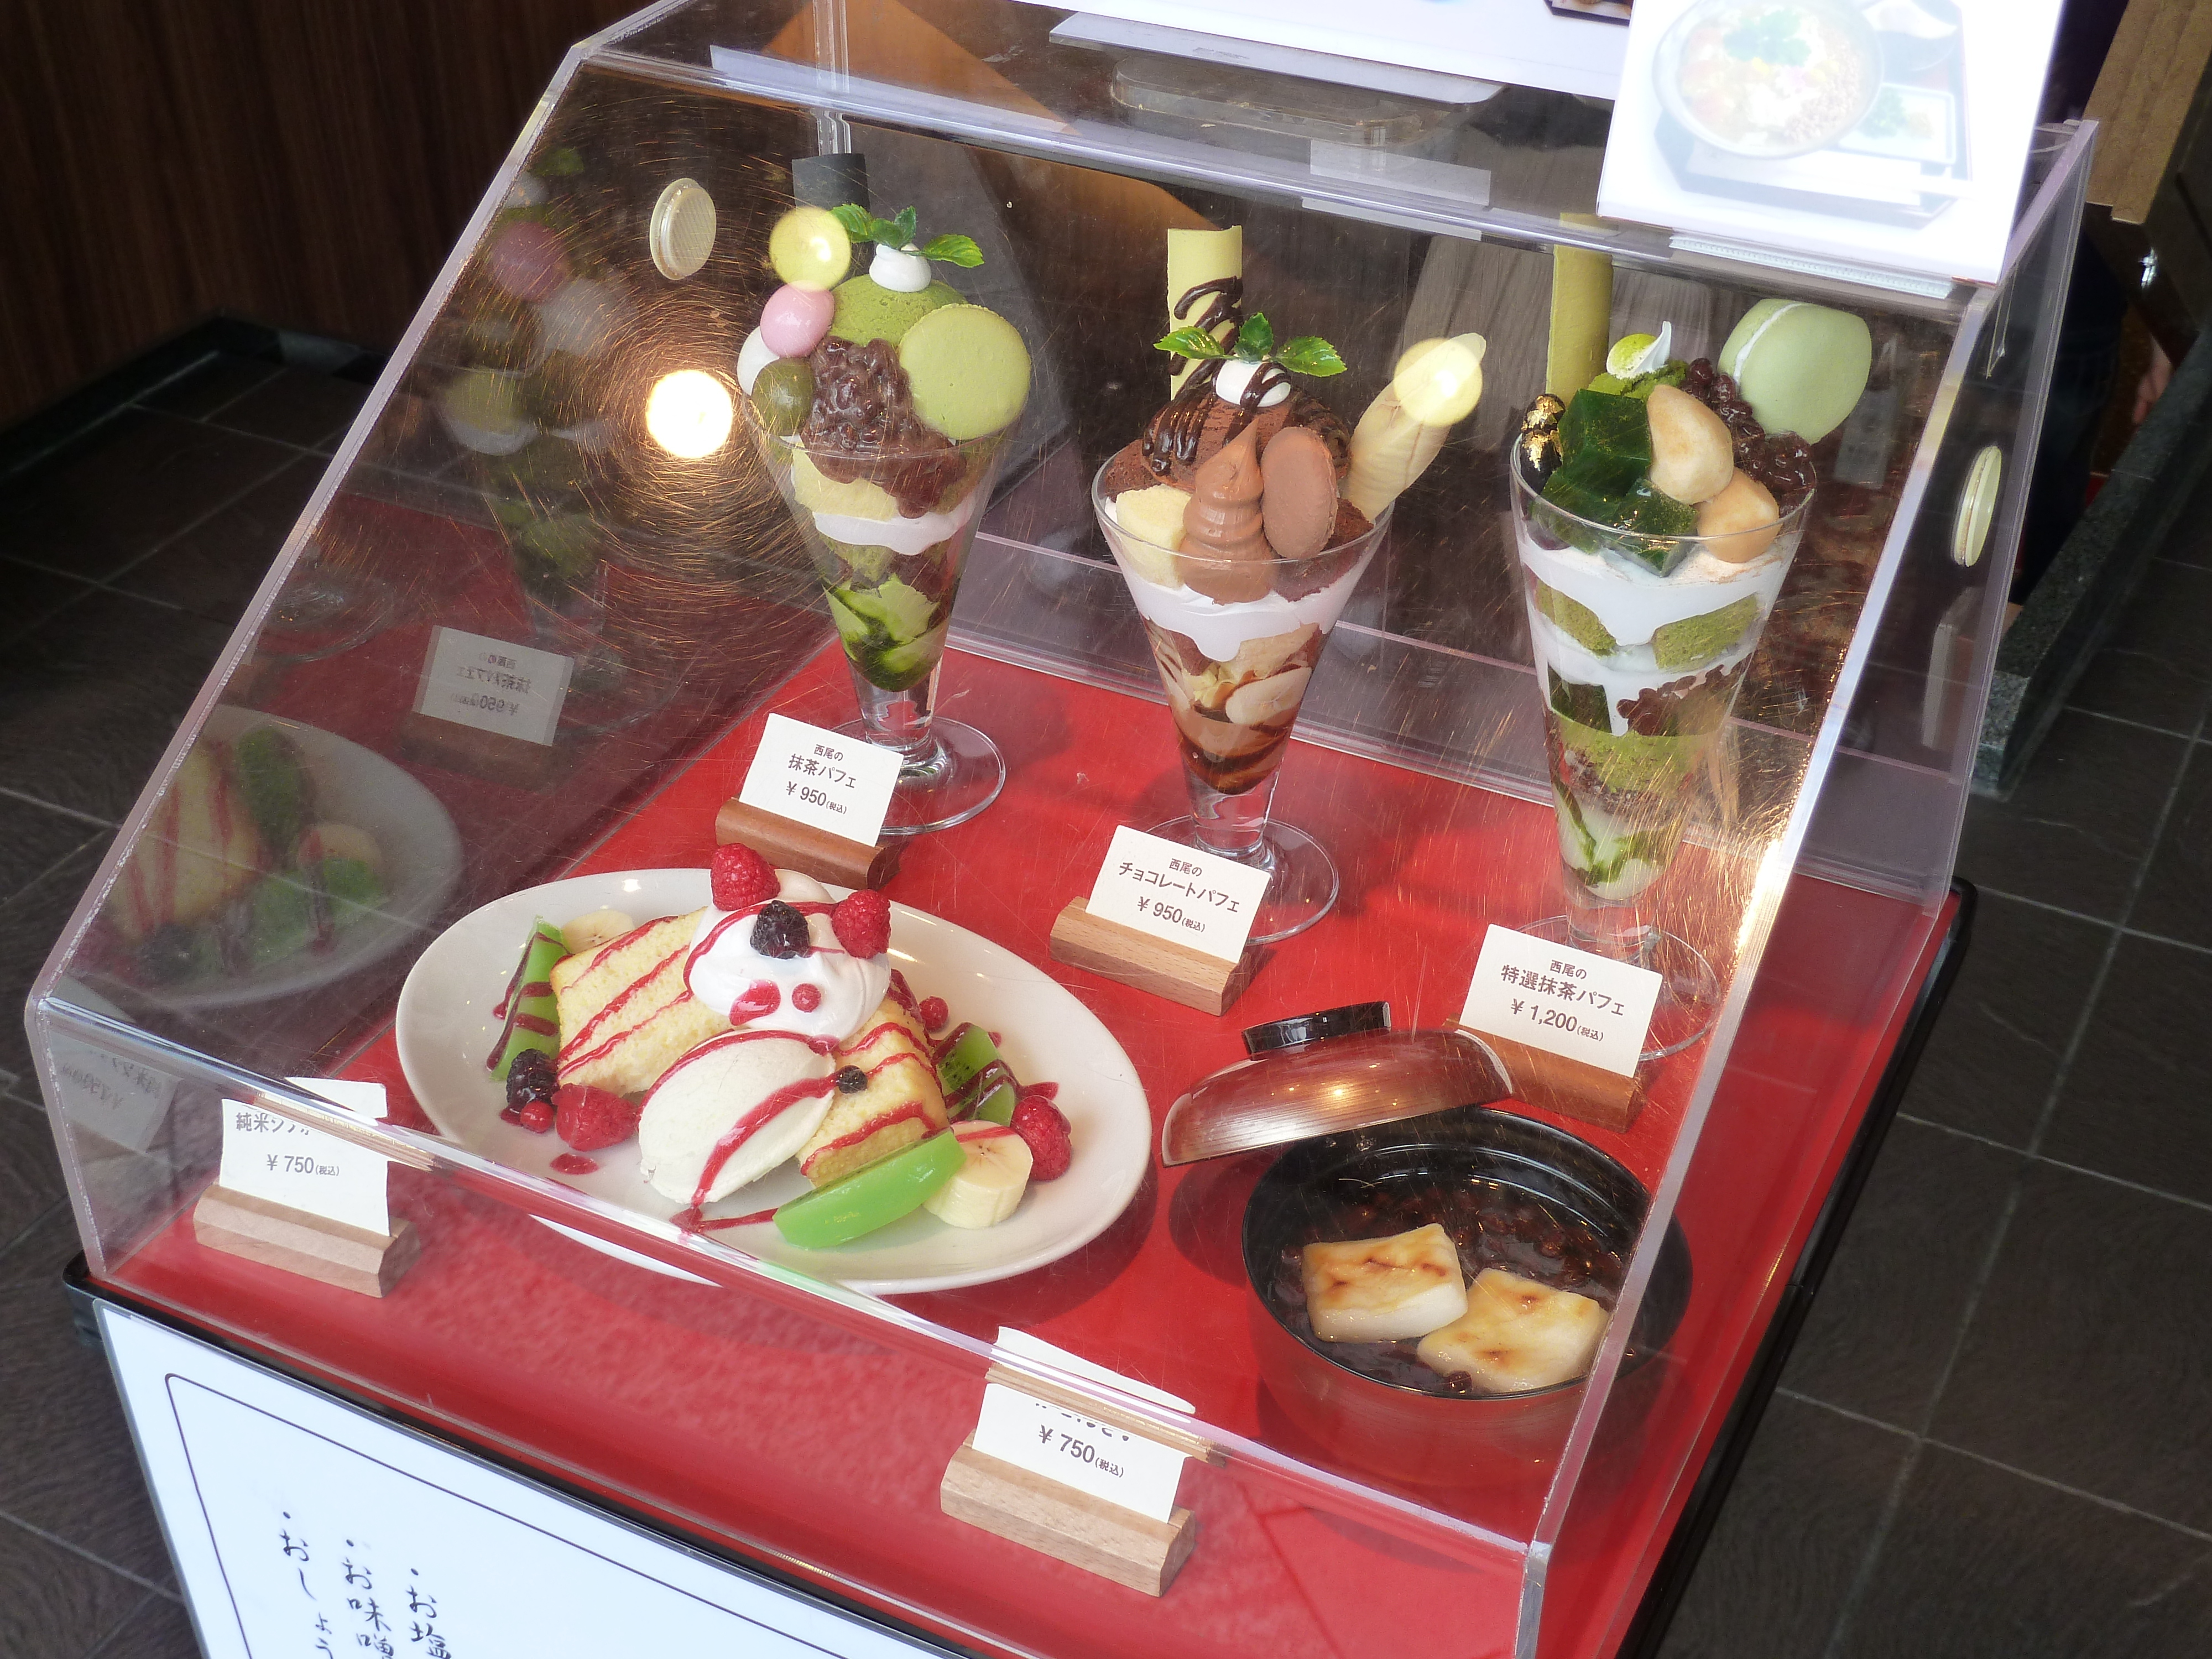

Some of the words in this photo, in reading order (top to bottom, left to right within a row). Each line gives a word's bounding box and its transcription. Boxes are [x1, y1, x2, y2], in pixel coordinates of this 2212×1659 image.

[813, 744, 843, 761] 西尾の
[788, 753, 857, 789] 抹茶パフェ
[1168, 858, 1202, 877] 西尾の
[1119, 862, 1240, 913] チョコレートパフェ
[1550, 959, 1587, 979] 西尾の
[1501, 964, 1625, 1016] 特選抹茶パフェ
